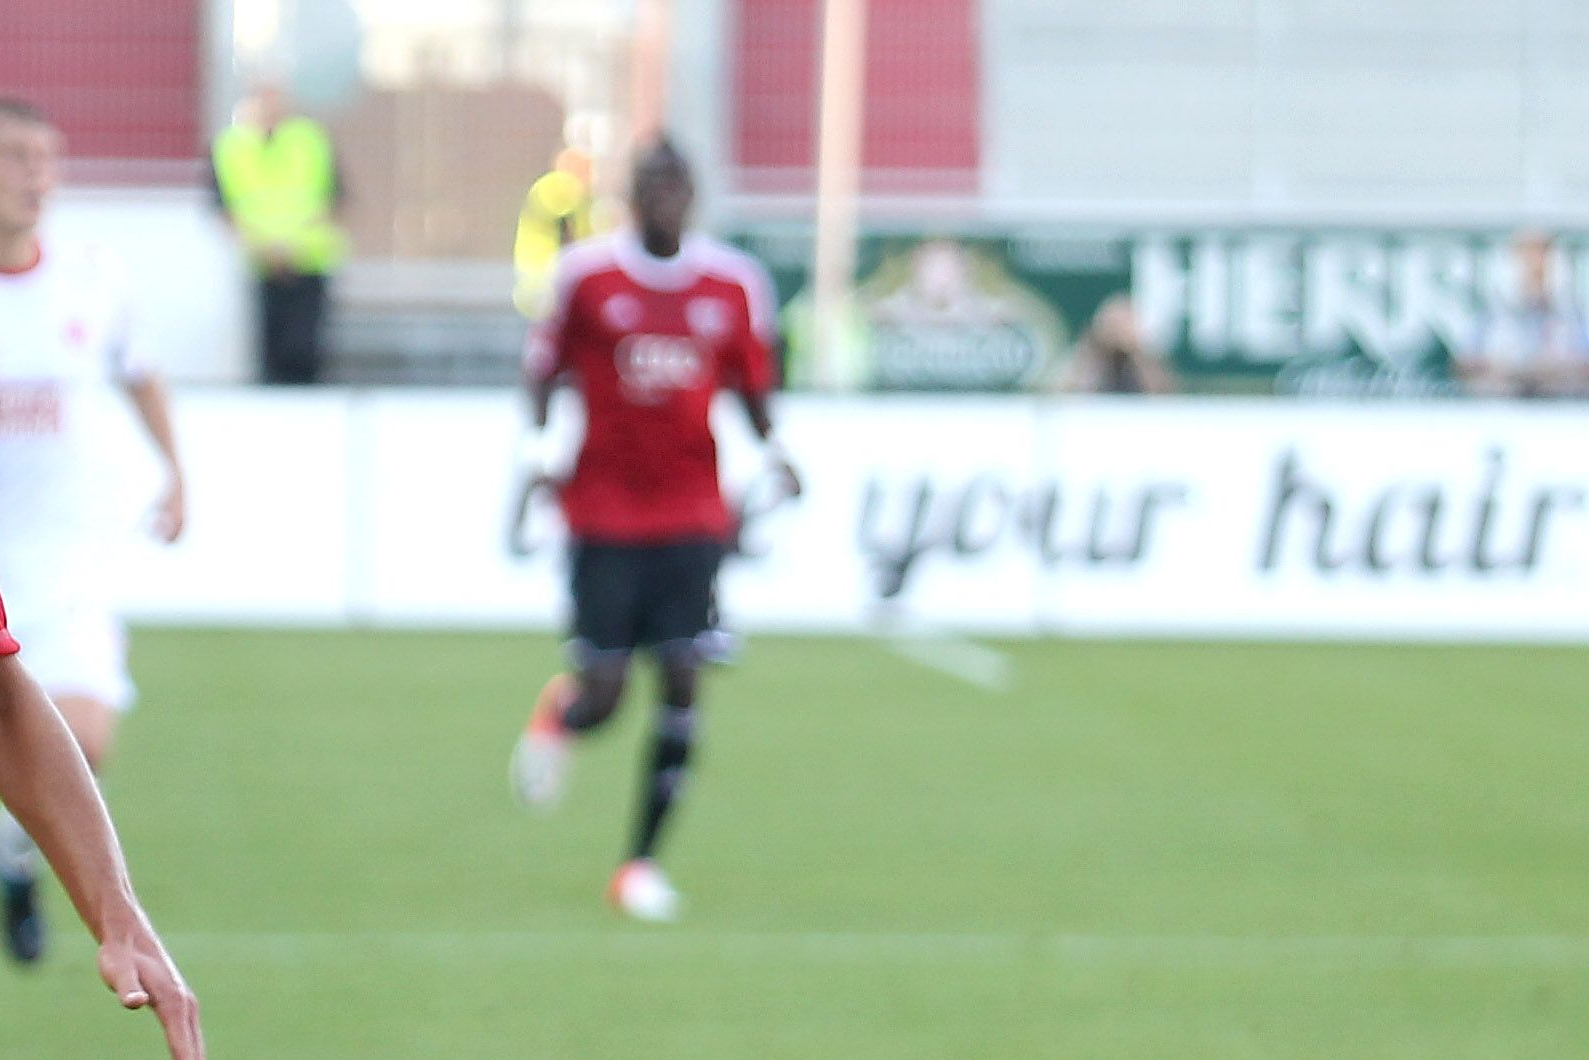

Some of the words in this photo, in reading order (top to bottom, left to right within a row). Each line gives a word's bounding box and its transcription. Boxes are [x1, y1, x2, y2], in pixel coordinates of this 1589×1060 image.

[1133, 238, 1571, 358] HERR
[857, 477, 1190, 602] your
[1254, 444, 1587, 574] hair
